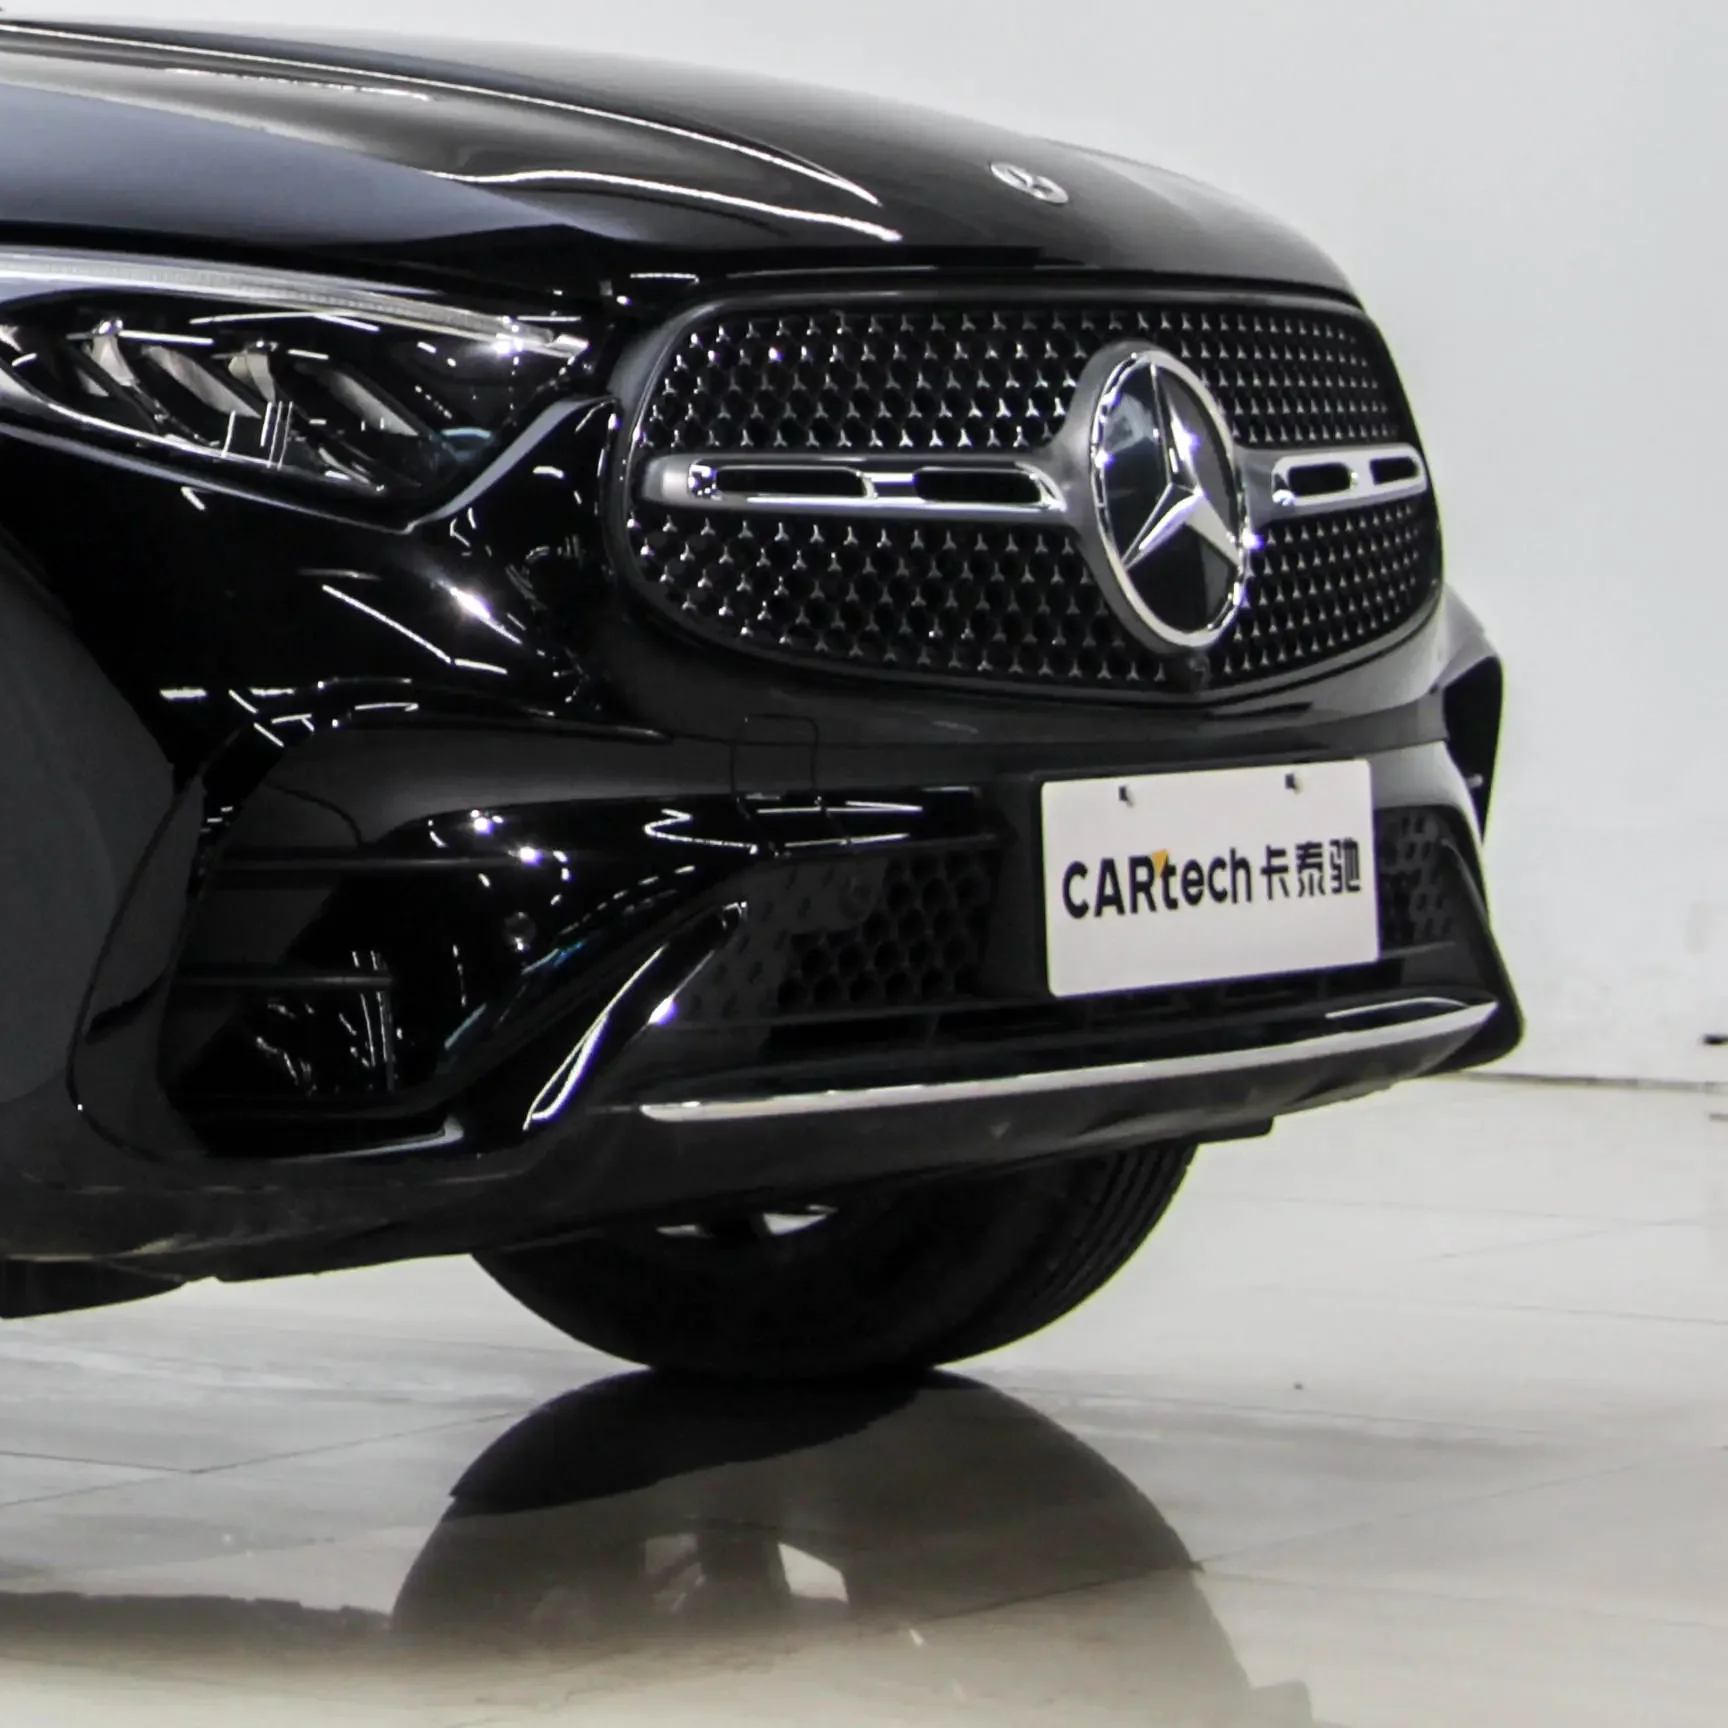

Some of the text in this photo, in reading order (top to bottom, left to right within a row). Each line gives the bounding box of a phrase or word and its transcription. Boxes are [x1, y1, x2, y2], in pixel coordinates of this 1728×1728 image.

[1061, 837, 1362, 920] CARtech 卡泰驰
